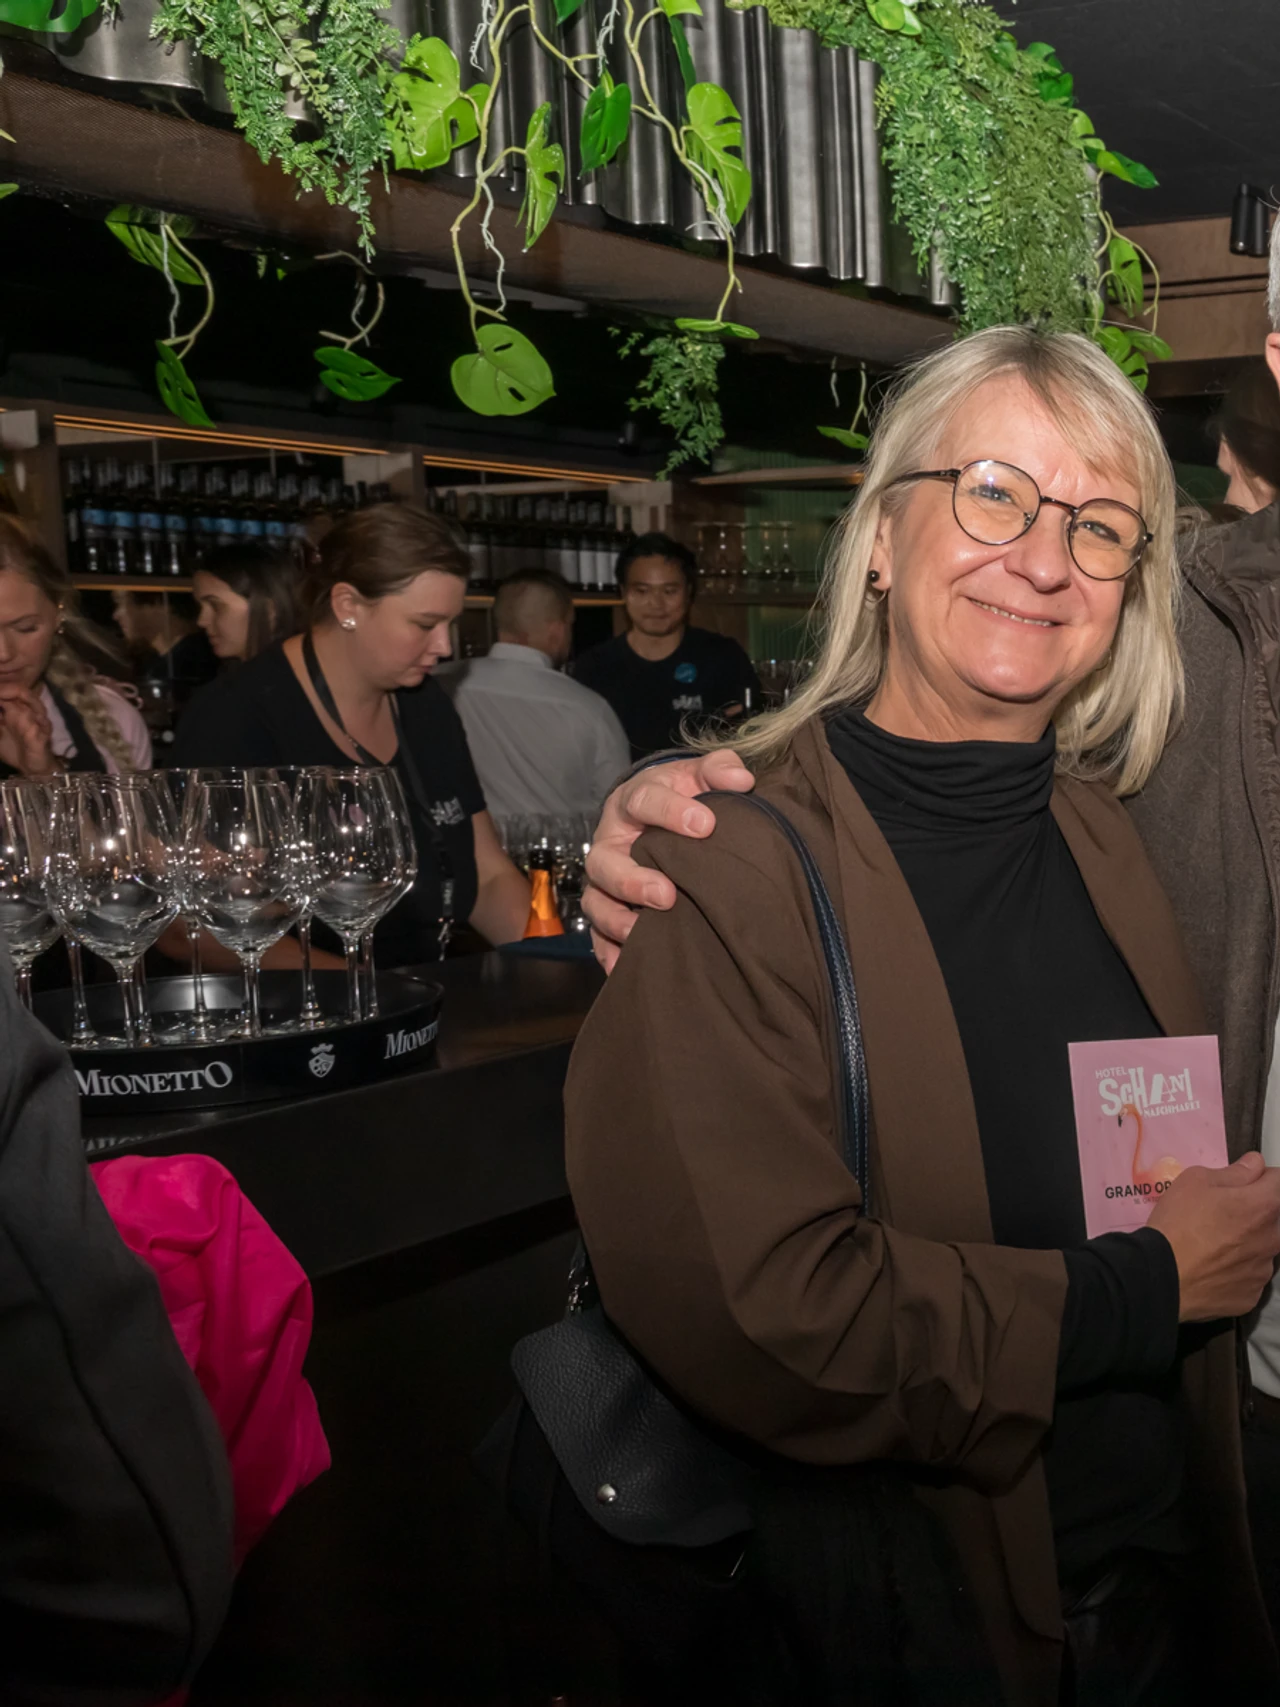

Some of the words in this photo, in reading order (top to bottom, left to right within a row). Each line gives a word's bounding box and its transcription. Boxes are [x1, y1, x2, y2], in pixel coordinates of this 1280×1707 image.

[74, 1061, 233, 1096] MIONETTO
[1096, 1066, 1127, 1079] HOTEL
[1105, 1183, 1152, 1199] GRAND
